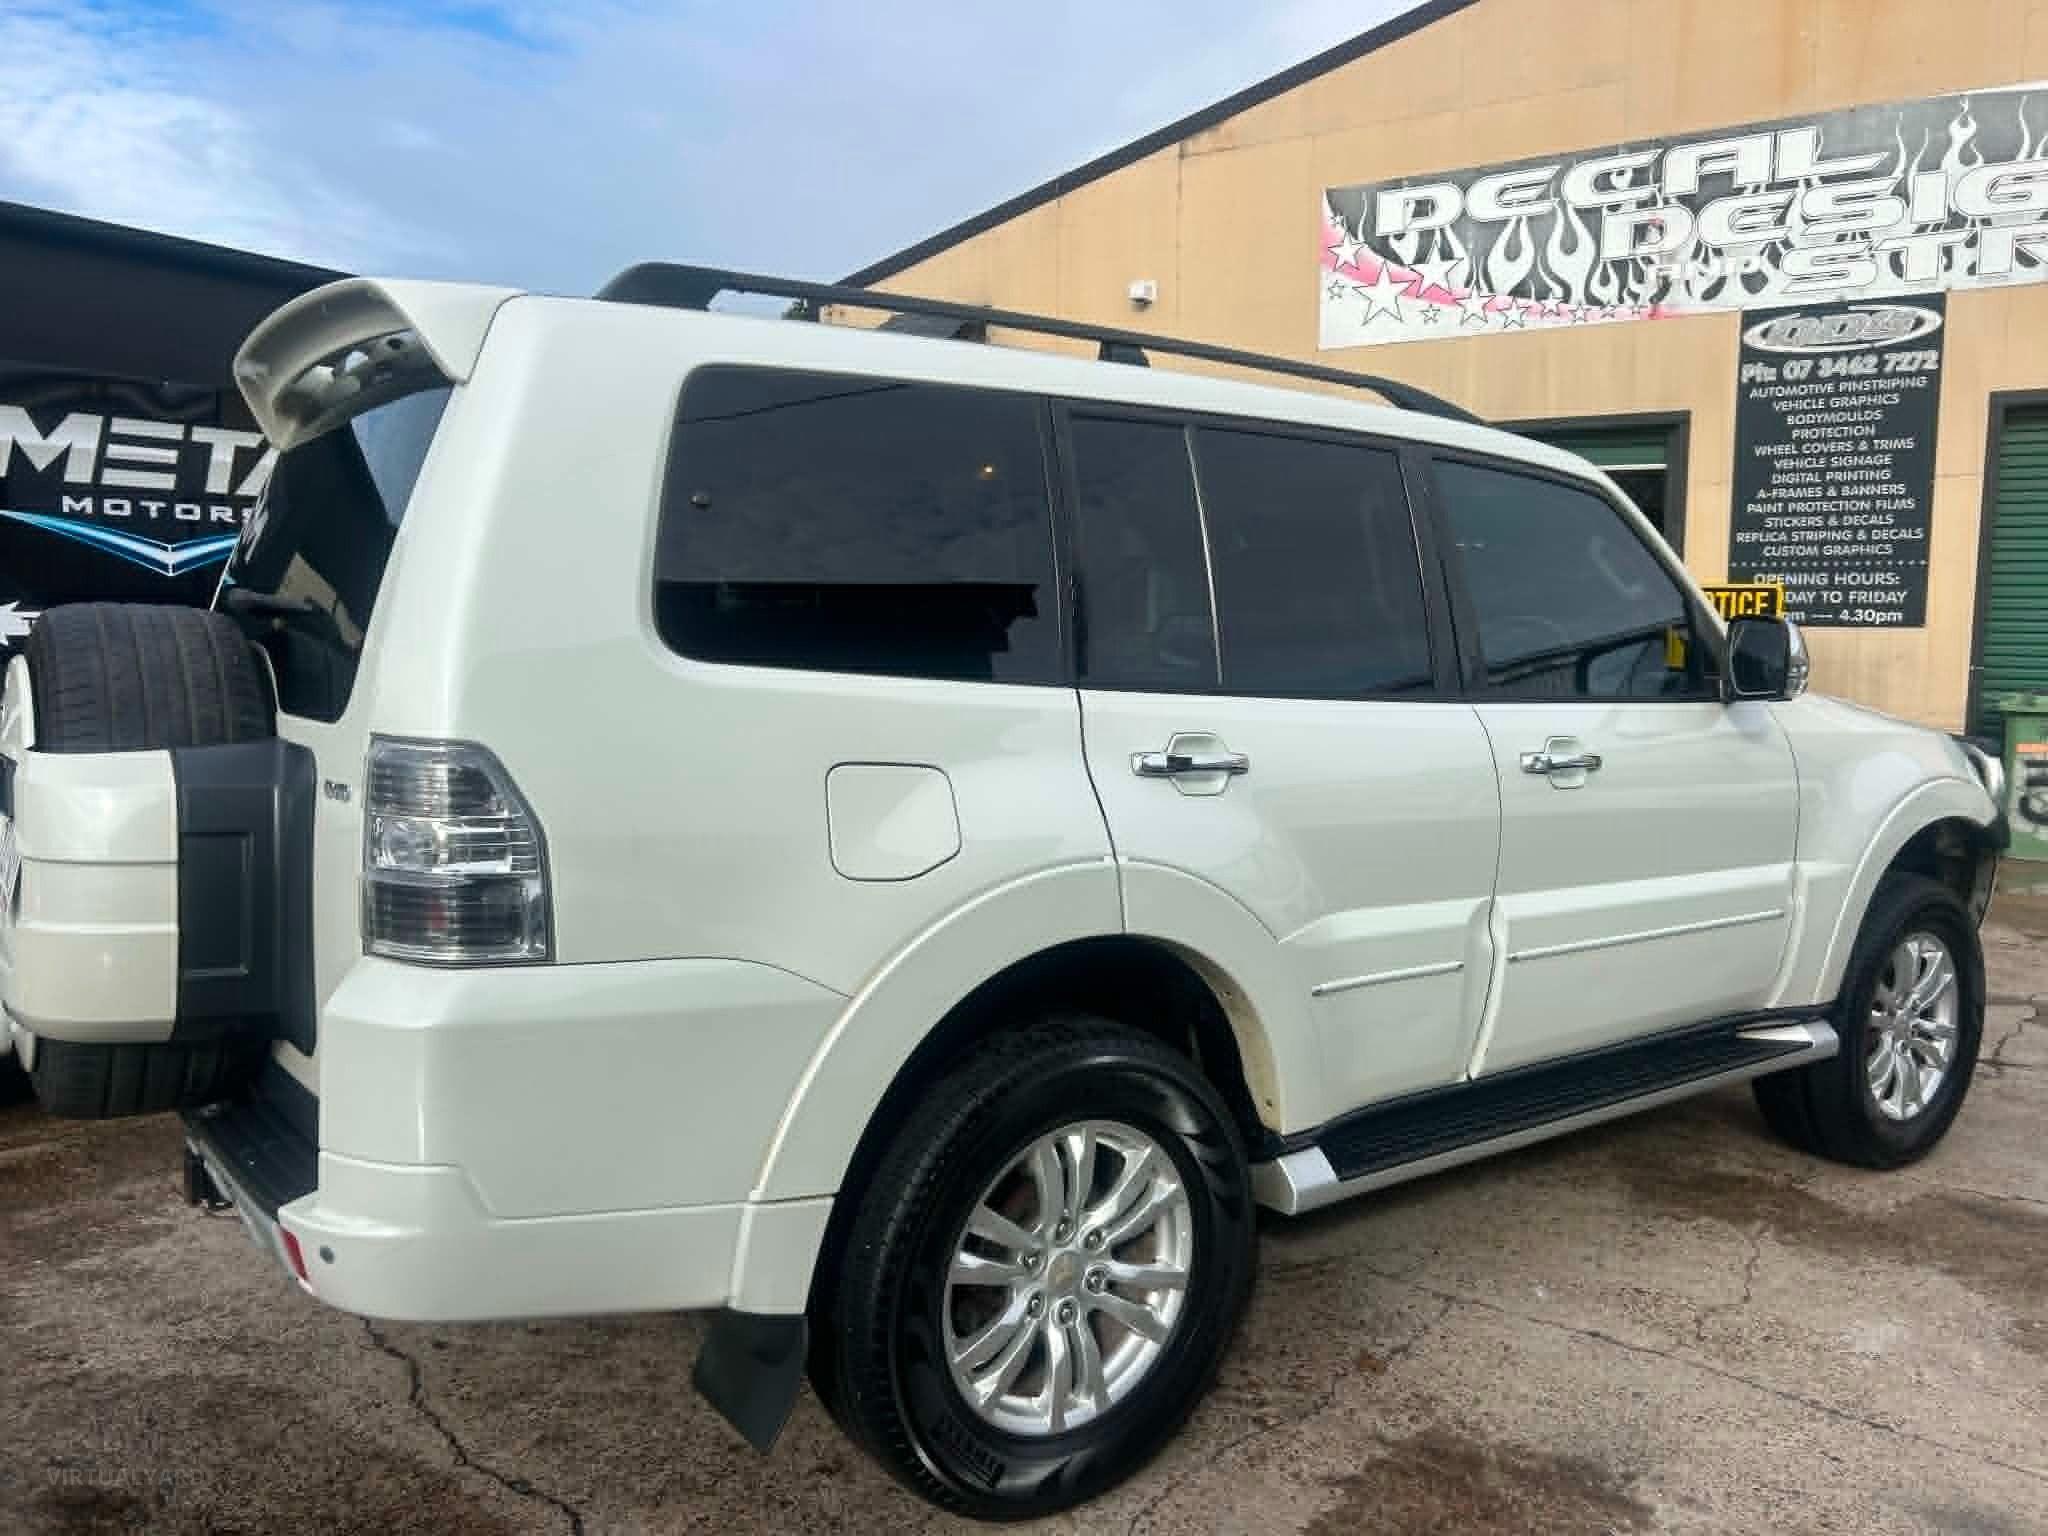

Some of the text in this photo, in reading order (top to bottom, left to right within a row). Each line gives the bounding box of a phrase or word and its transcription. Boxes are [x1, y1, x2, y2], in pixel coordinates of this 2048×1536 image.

[1375, 126, 1891, 238] DECAL
[1783, 359, 1814, 380] 07
[1817, 354, 1878, 377] 3462
[1883, 350, 1938, 373] 7272
[1750, 377, 1928, 399] AUTOMOTIVE PINSTRIPING
[1773, 394, 1900, 411] VEHICLE GRAPHICS
[1787, 410, 1882, 424] BODYMOULDS
[1792, 424, 1876, 440] PROTECTION
[1754, 445, 1798, 457] WHEEL
[1802, 441, 1854, 454] COVERS
[1873, 438, 1914, 450] TRIMS
[1774, 454, 1893, 470] VEHICLE SIGNAGE
[1772, 470, 1891, 484] DIGITAL PRINTING
[1757, 484, 1906, 499] A-FRAMES & BANNERS
[1747, 499, 1915, 513] PAINT PROTECTION FILMS
[1764, 513, 1895, 528] STICKERS & DECALS
[1736, 528, 1924, 543] REPLICA STRIPING & DECALS
[1763, 544, 1893, 557] CUSTOM GRAPHICS
[1752, 573, 1901, 585] OPENING HOURS:
[1821, 592, 1841, 604] TO
[1849, 591, 1907, 603] FRIDAY
[1839, 609, 1903, 624] 4.30pm
